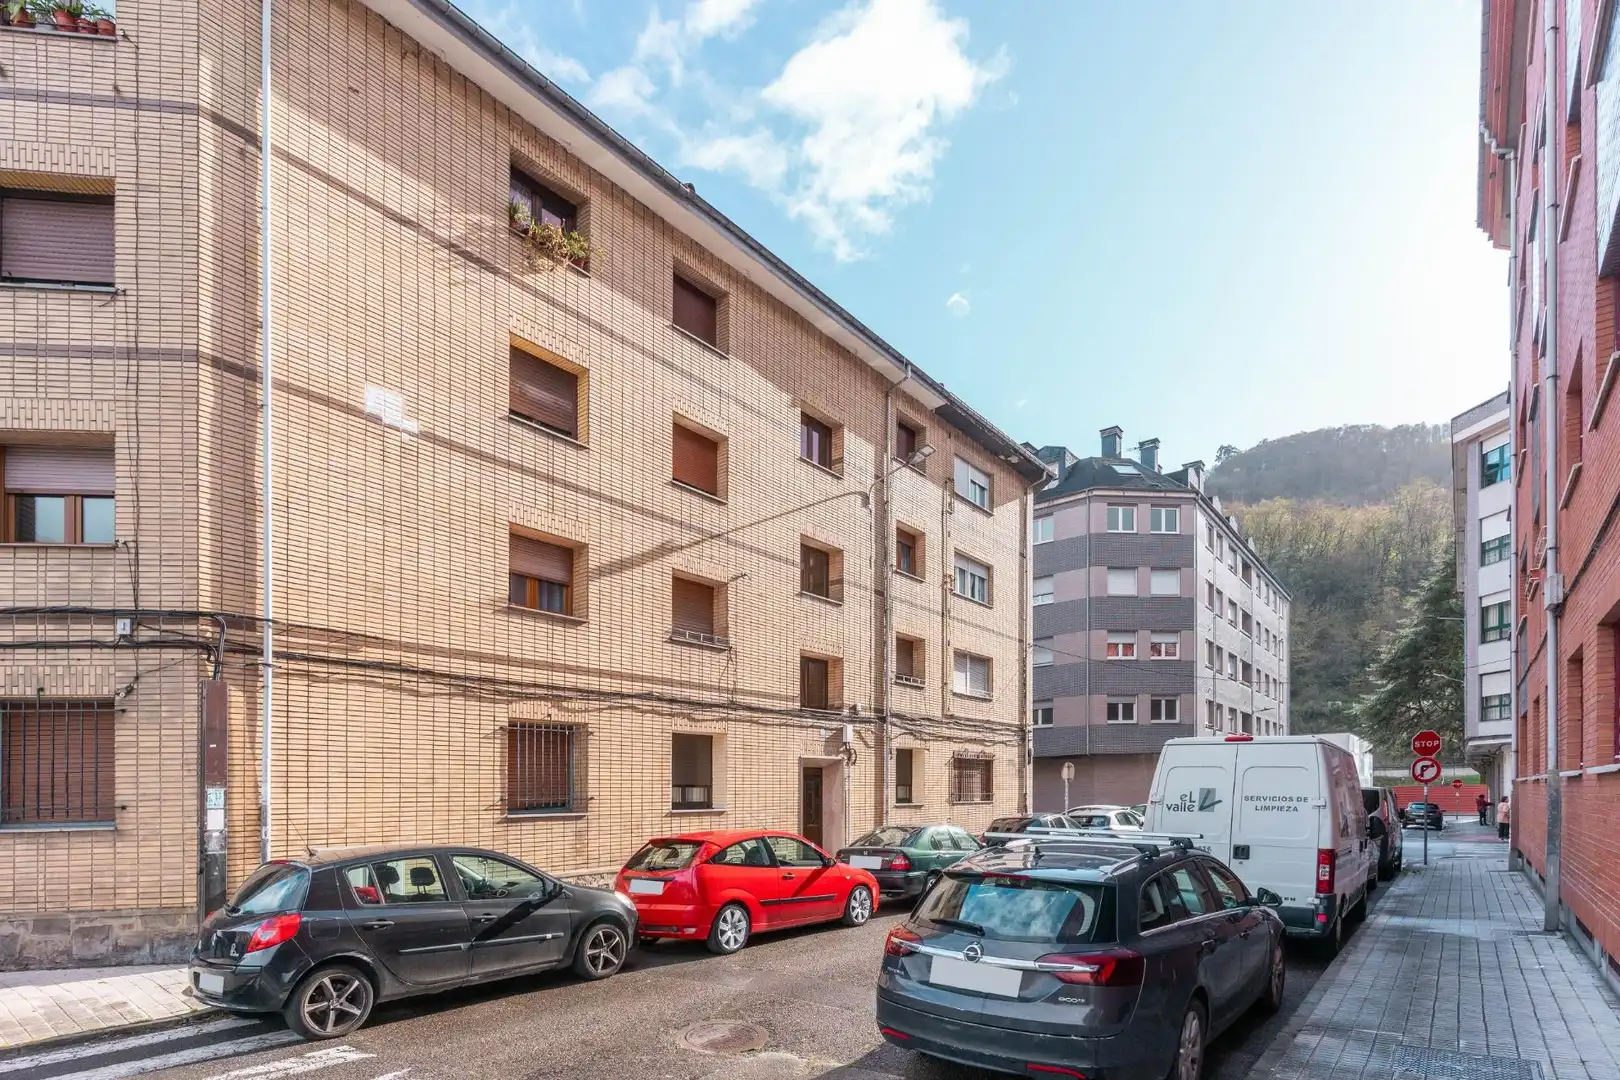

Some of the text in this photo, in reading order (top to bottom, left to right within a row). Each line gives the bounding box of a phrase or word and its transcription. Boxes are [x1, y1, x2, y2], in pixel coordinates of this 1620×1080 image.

[1414, 740, 1439, 748] STOP
[1244, 795, 1294, 803] SERVICIOS
[1165, 802, 1195, 812] valle
